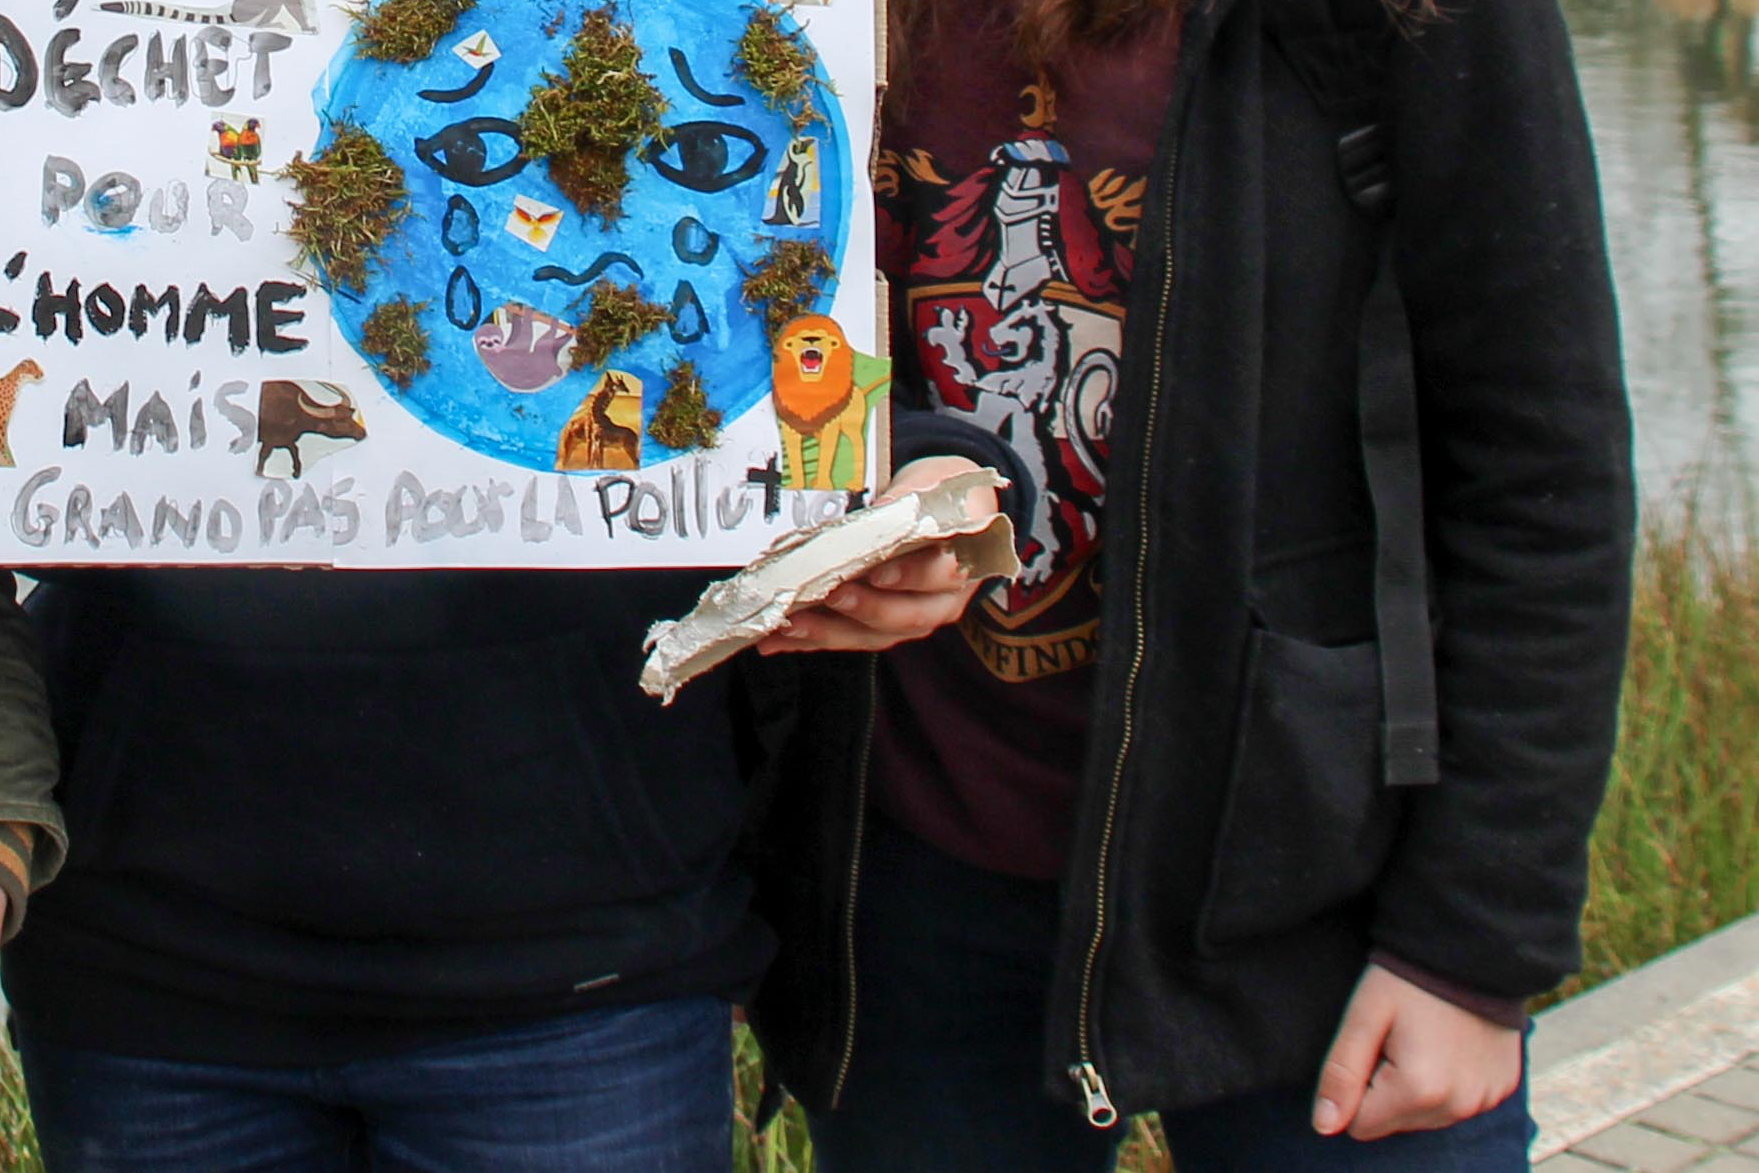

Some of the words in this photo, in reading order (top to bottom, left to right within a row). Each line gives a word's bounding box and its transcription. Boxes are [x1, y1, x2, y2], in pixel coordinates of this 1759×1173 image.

[41, 155, 254, 241] POUR
[12, 466, 241, 552] GRAND
[257, 476, 361, 547] PAS
[520, 475, 584, 543] LA
